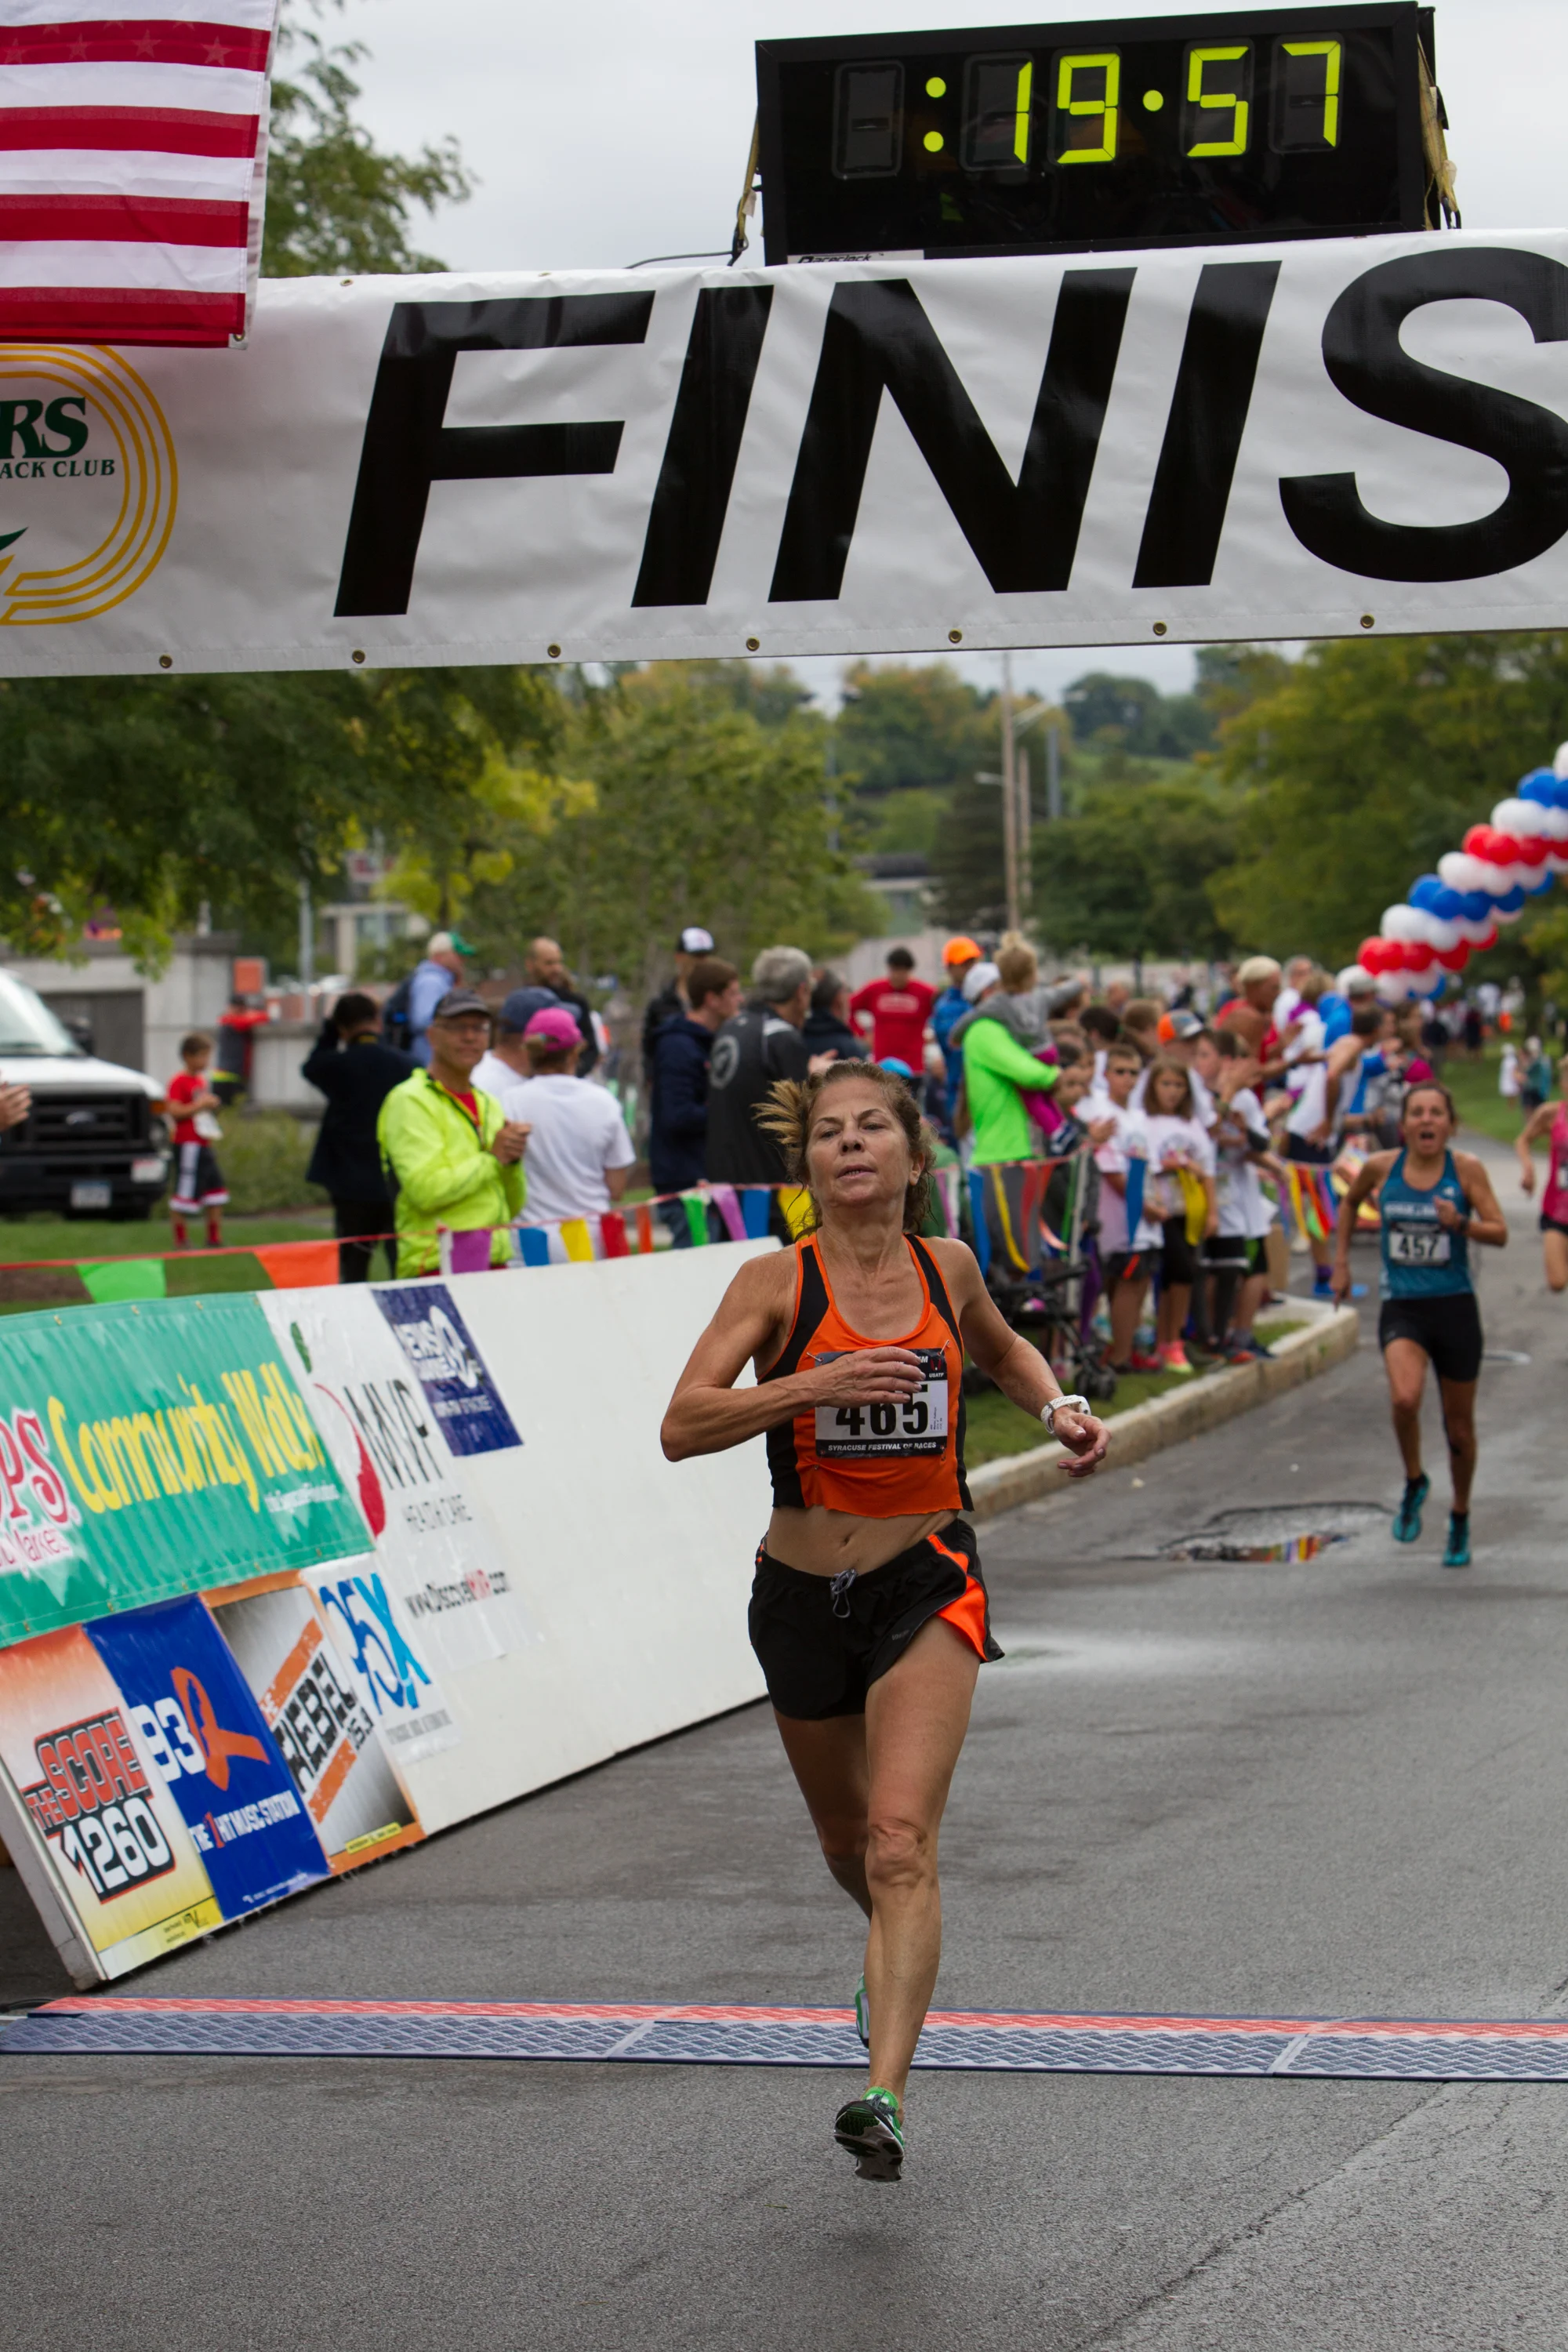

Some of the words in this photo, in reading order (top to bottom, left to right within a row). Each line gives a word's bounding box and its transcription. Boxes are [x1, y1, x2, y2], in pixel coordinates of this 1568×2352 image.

[52, 459, 115, 477] CLUB
[333, 247, 1568, 616] FINIS
[1398, 1234, 1439, 1258] 457
[0, 1414, 68, 1523] PS
[47, 1373, 260, 1514] Community
[220, 1361, 327, 1477] Walk
[343, 1378, 444, 1490] MVP
[835, 1384, 928, 1436] 465
[914, 1441, 937, 1450] RACES
[272, 1651, 357, 1795] REBEL
[38, 1715, 149, 1821] SCORE
[24, 1785, 67, 1831] THE
[63, 1796, 171, 1894] 1260
[256, 1789, 301, 1826] STATION
